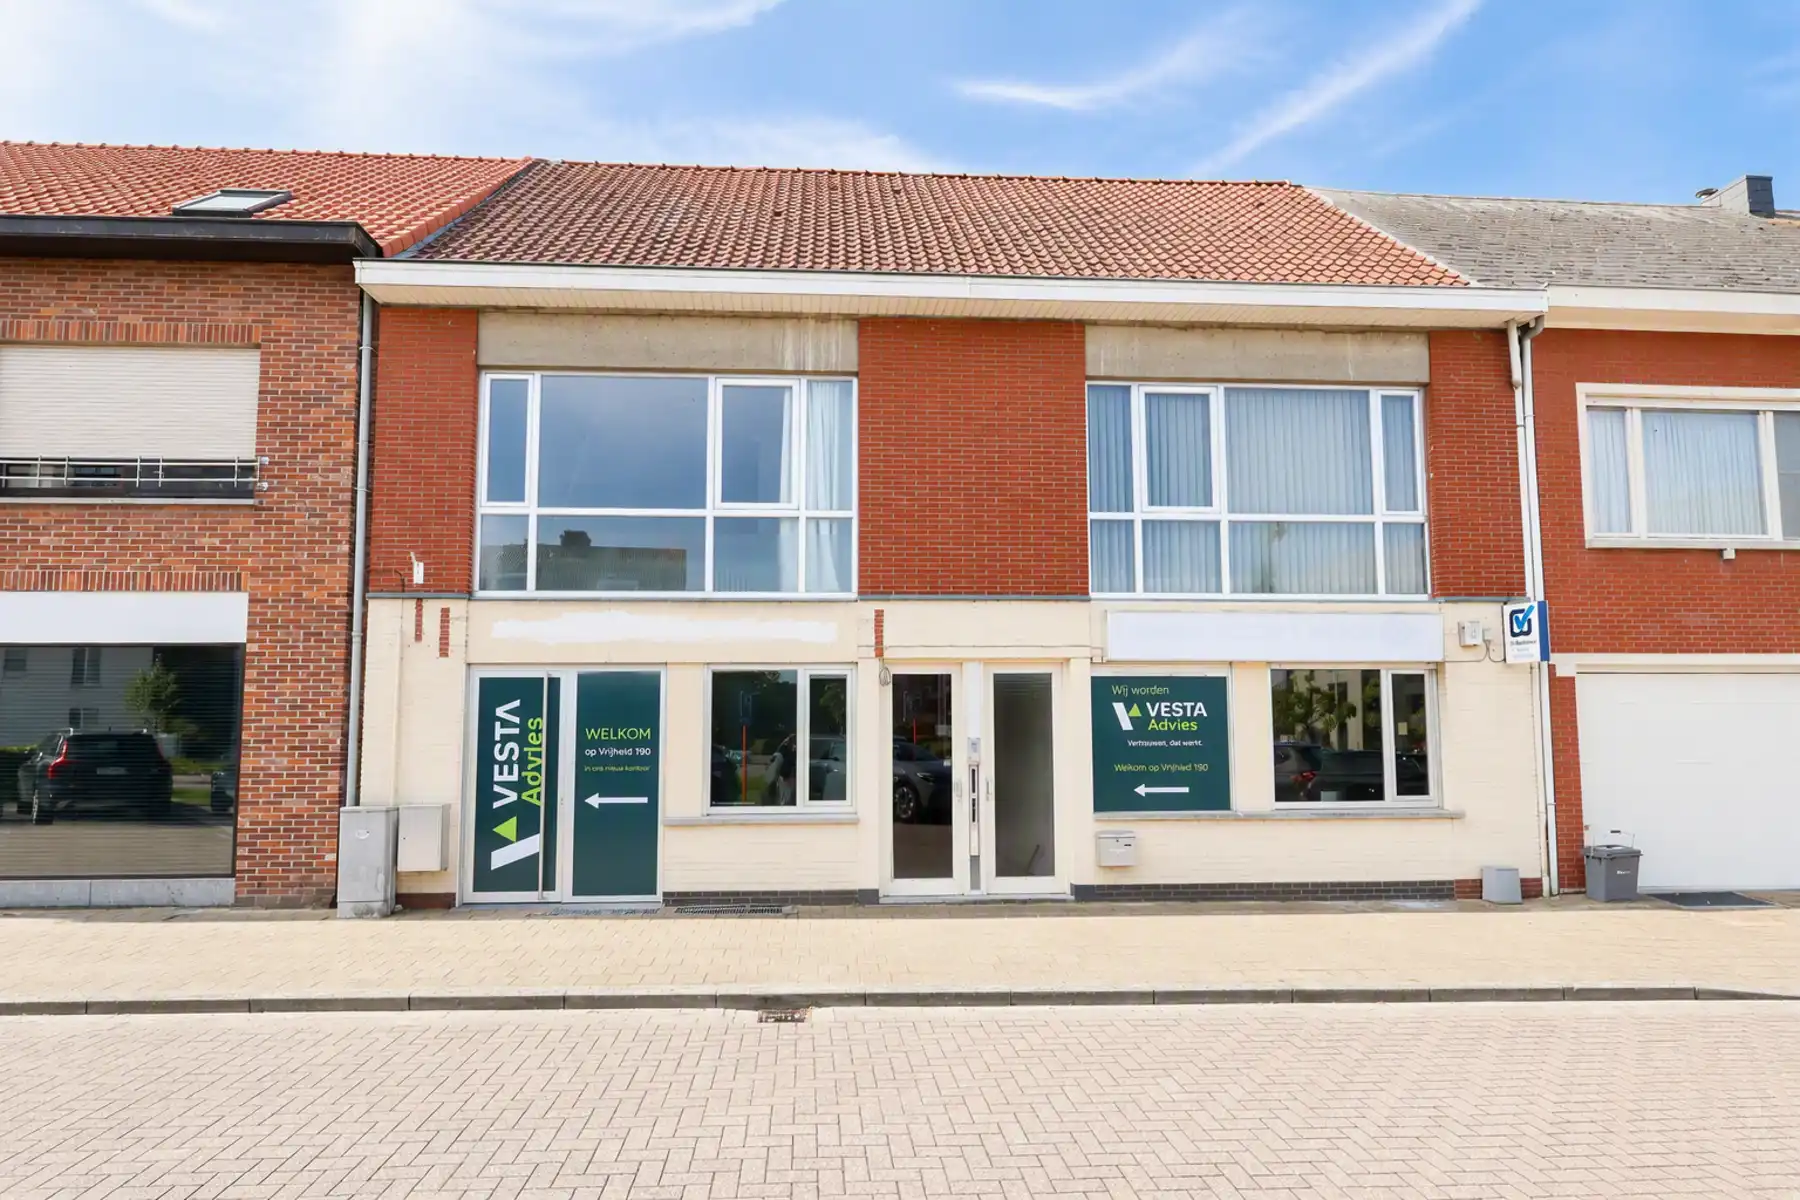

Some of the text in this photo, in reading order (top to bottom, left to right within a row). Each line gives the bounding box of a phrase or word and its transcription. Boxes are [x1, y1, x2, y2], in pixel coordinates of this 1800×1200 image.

[1111, 685, 1170, 697] Wij worden
[1146, 702, 1208, 717] VESTA
[1148, 718, 1198, 731] Advies
[585, 728, 651, 740] WELKOM
[492, 699, 521, 809] VESTA
[584, 747, 652, 758] op Vrijheid 190
[521, 717, 543, 807] Advies
[1114, 763, 1147, 772] Welkom
[1148, 764, 1160, 773] op
[1194, 763, 1209, 772] 190
